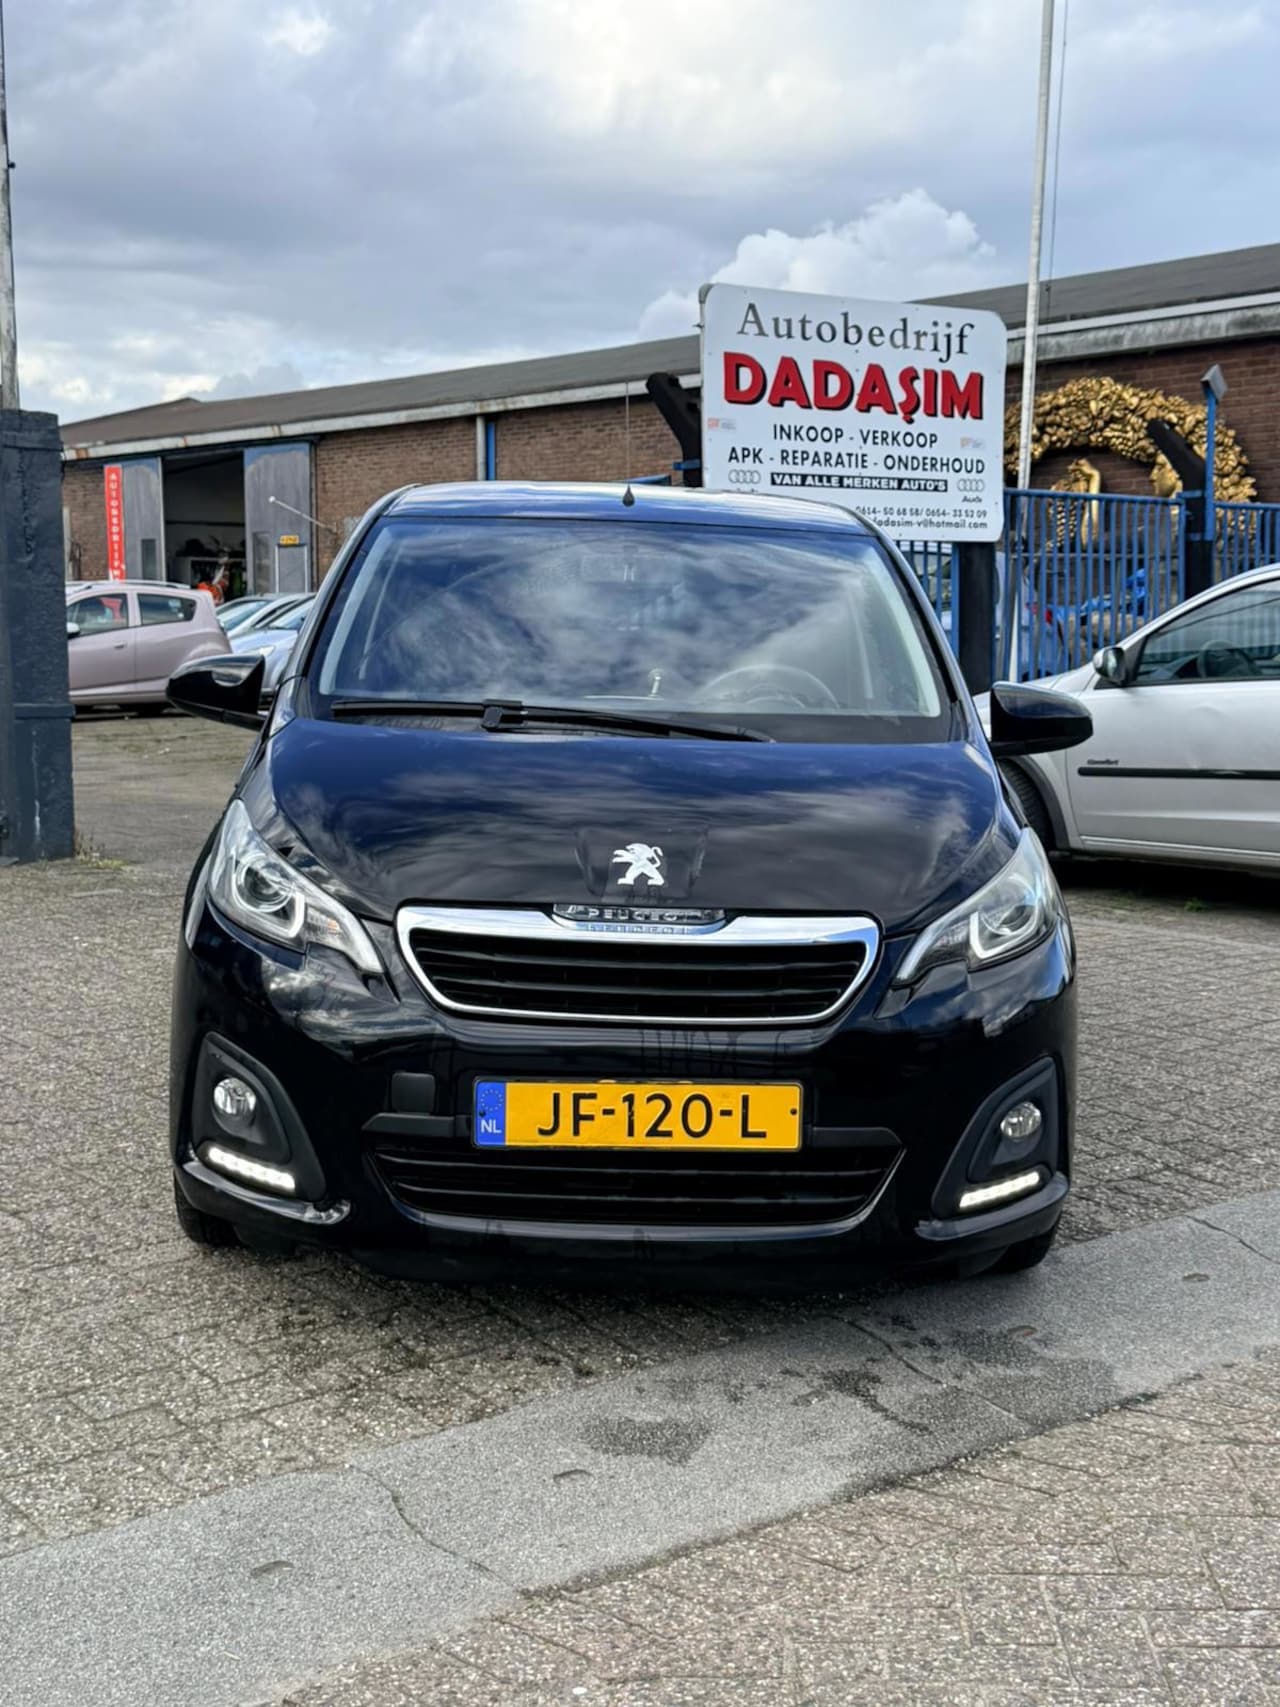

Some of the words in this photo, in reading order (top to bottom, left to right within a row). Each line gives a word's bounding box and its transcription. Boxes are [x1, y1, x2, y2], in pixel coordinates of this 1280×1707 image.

[737, 303, 975, 364] Autobedrijf
[723, 351, 984, 424] DADAŞIM
[773, 424, 844, 443] INKOOP
[860, 429, 938, 448] VERKOOP
[728, 447, 763, 465] APK
[780, 450, 868, 469] REPARATIE
[884, 454, 985, 474] ONDERHOUD
[773, 474, 801, 486] VAN
[804, 476, 840, 488] ALLE
[843, 477, 898, 490] MERKEN
[901, 480, 946, 491] AUTO'S
[480, 1120, 502, 1134] NL
[537, 1092, 767, 1139] JF-120-L
